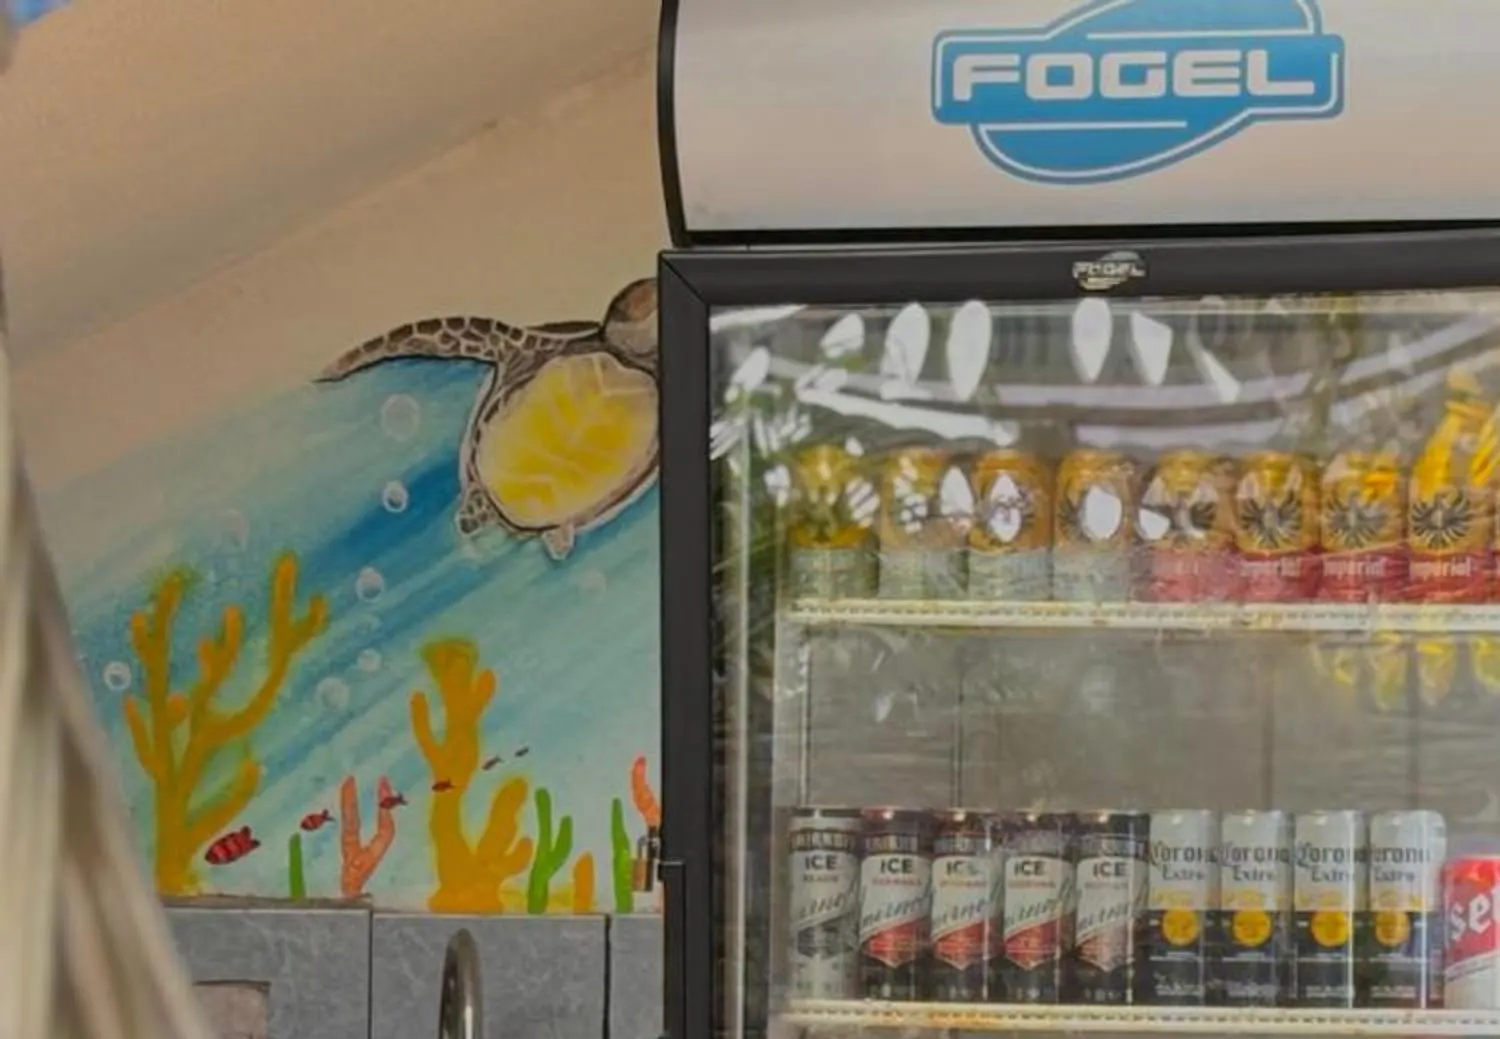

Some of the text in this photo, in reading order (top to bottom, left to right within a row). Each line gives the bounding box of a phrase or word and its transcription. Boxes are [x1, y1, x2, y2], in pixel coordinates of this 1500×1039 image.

[952, 49, 1315, 102] FOGEL
[804, 854, 838, 871] ICE
[880, 858, 913, 875] ICE
[1014, 859, 1045, 876] ICE
[1092, 860, 1128, 878] ICE
